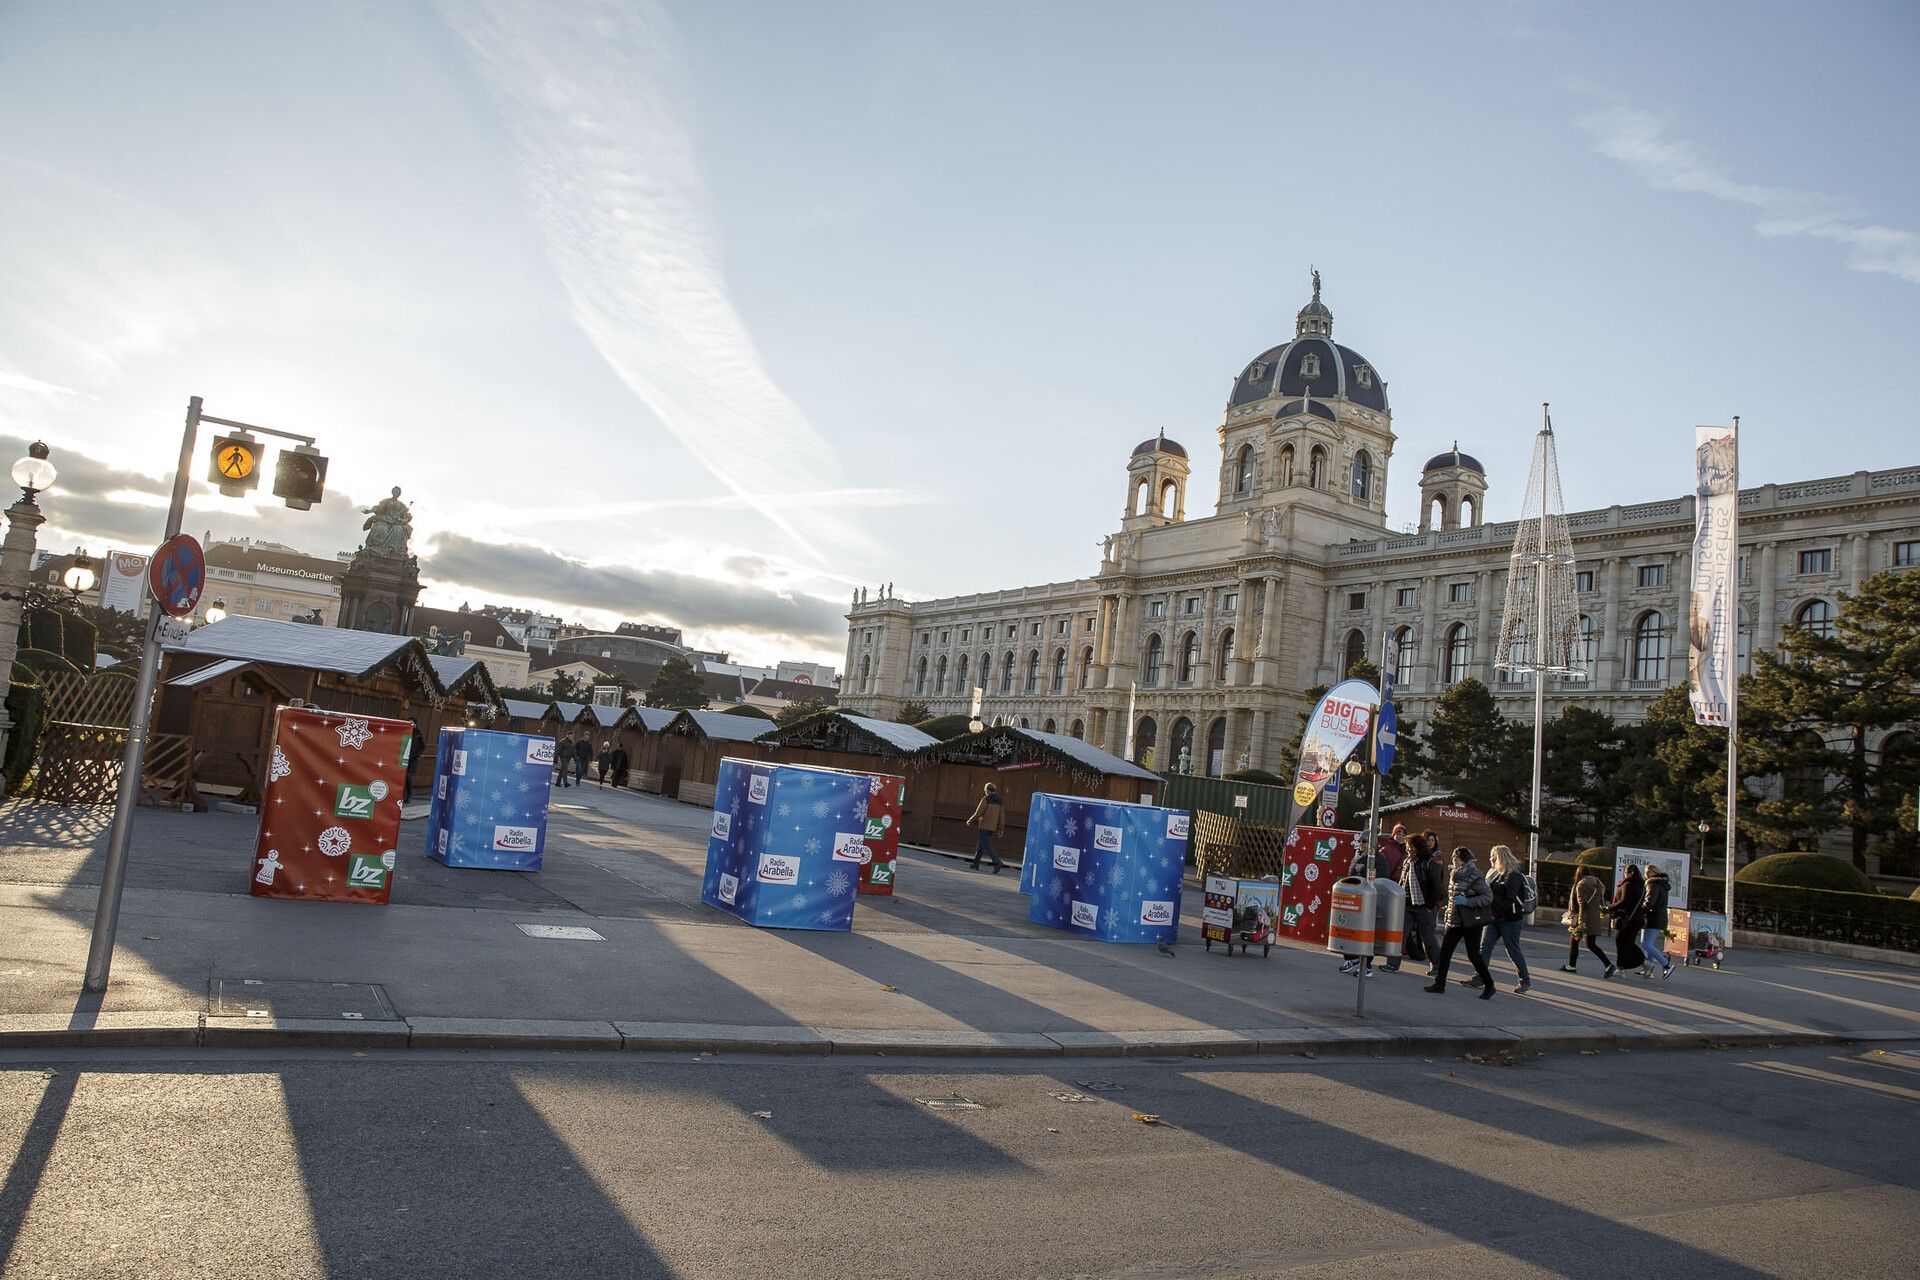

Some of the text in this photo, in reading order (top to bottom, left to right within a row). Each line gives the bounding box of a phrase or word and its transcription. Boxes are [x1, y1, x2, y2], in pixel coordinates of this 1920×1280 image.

[256, 562, 334, 582] MuseumsQuartier
[162, 622, 184, 641] Ende
[1324, 699, 1351, 718] BIG
[1321, 714, 1349, 733] BUS
[338, 787, 371, 814] bz
[865, 819, 883, 837] bz
[1315, 841, 1330, 859] bz
[351, 857, 383, 884] bz
[769, 858, 786, 867] Radio
[872, 864, 890, 882] bz
[1283, 907, 1297, 924] bz
